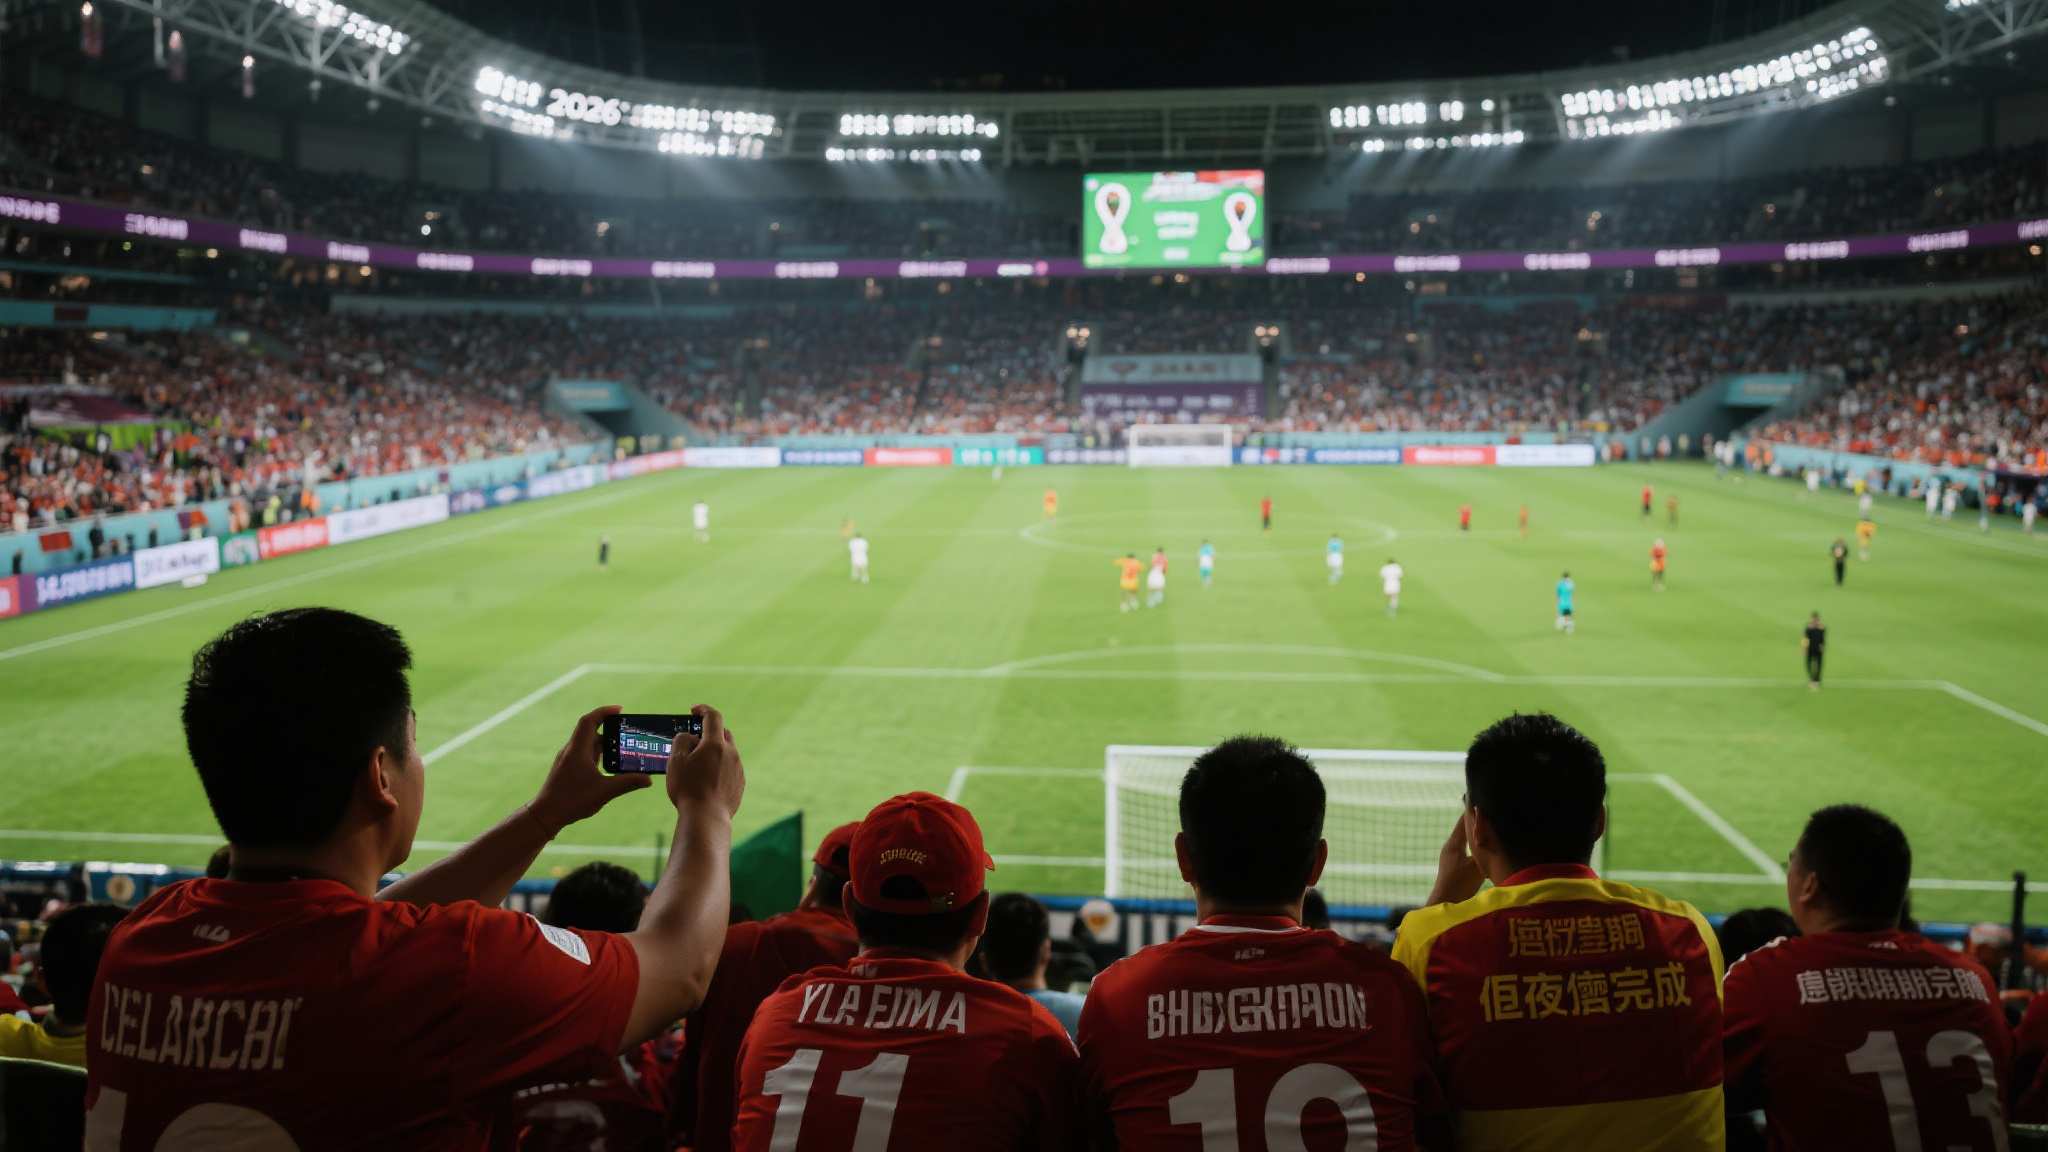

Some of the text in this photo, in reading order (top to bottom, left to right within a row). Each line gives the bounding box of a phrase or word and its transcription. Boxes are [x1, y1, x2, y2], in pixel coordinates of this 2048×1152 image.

[546, 88, 621, 126] 2026
[762, 1048, 910, 1152] 11
[1846, 1030, 2010, 1152] 13
